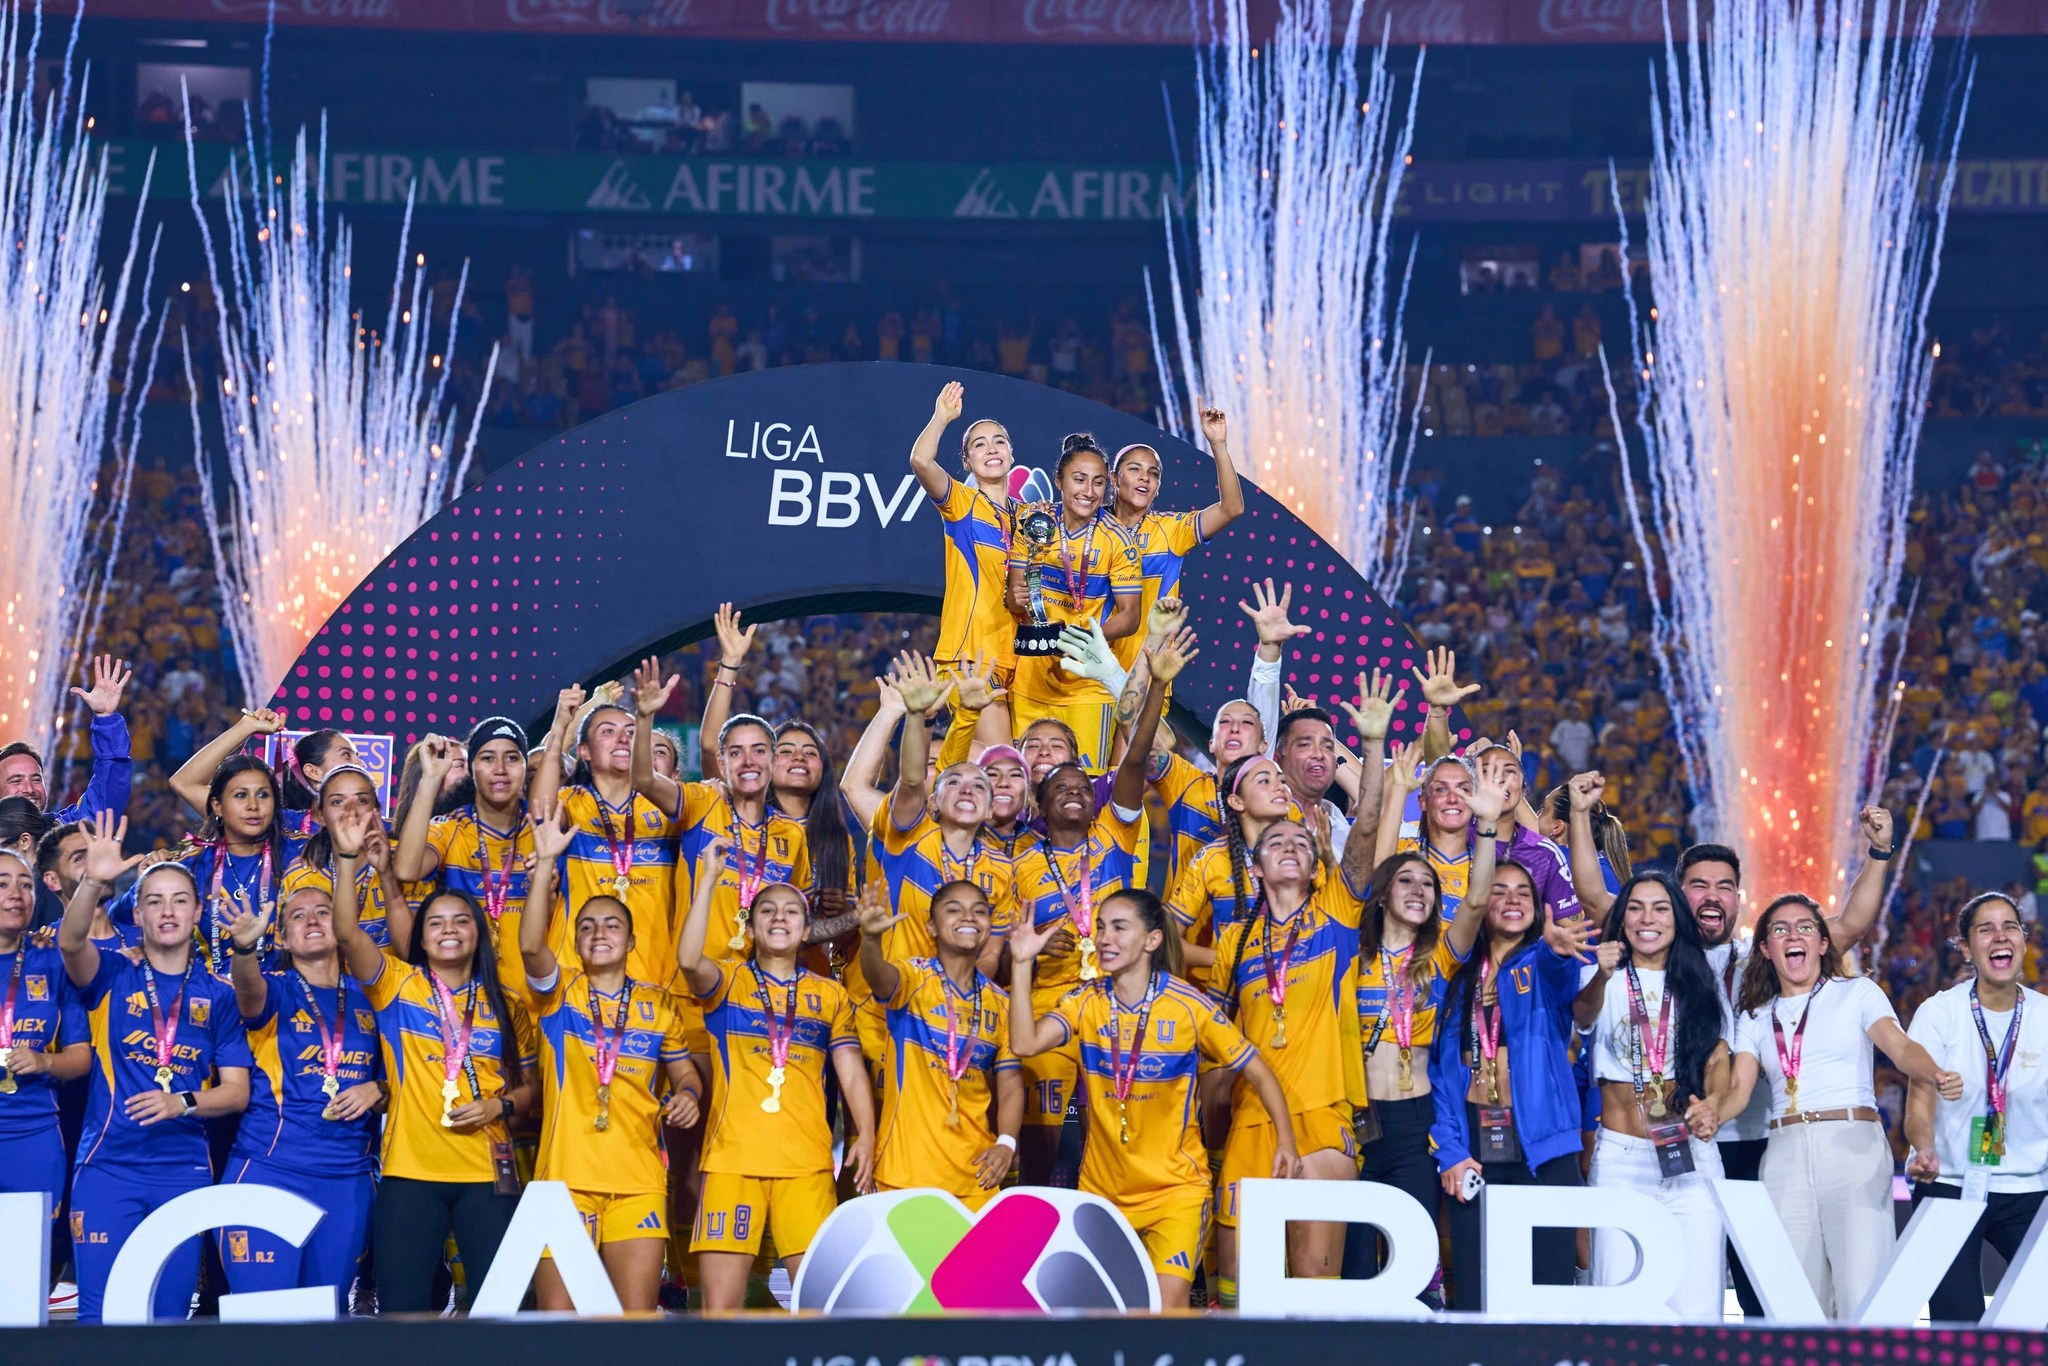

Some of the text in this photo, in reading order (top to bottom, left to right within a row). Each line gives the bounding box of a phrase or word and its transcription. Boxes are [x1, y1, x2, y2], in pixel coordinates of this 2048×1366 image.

[664, 164, 875, 215] AFIRME
[1030, 170, 1202, 219] AFIRM
[1425, 181, 1562, 204] LIGHT
[725, 419, 824, 463] LIGA
[1511, 964, 1532, 994] U
[12, 1018, 47, 1033] MEX
[1157, 1020, 1176, 1042] U
[1378, 1008, 1390, 1029] BBVA
[143, 1035, 202, 1062] CMEX
[316, 1049, 374, 1066] CMEX
[1633, 1044, 1641, 1065] BBVA
[1634, 1076, 1643, 1091] LIGA
[1035, 1079, 1063, 1114] 16
[734, 1204, 751, 1240] 8
